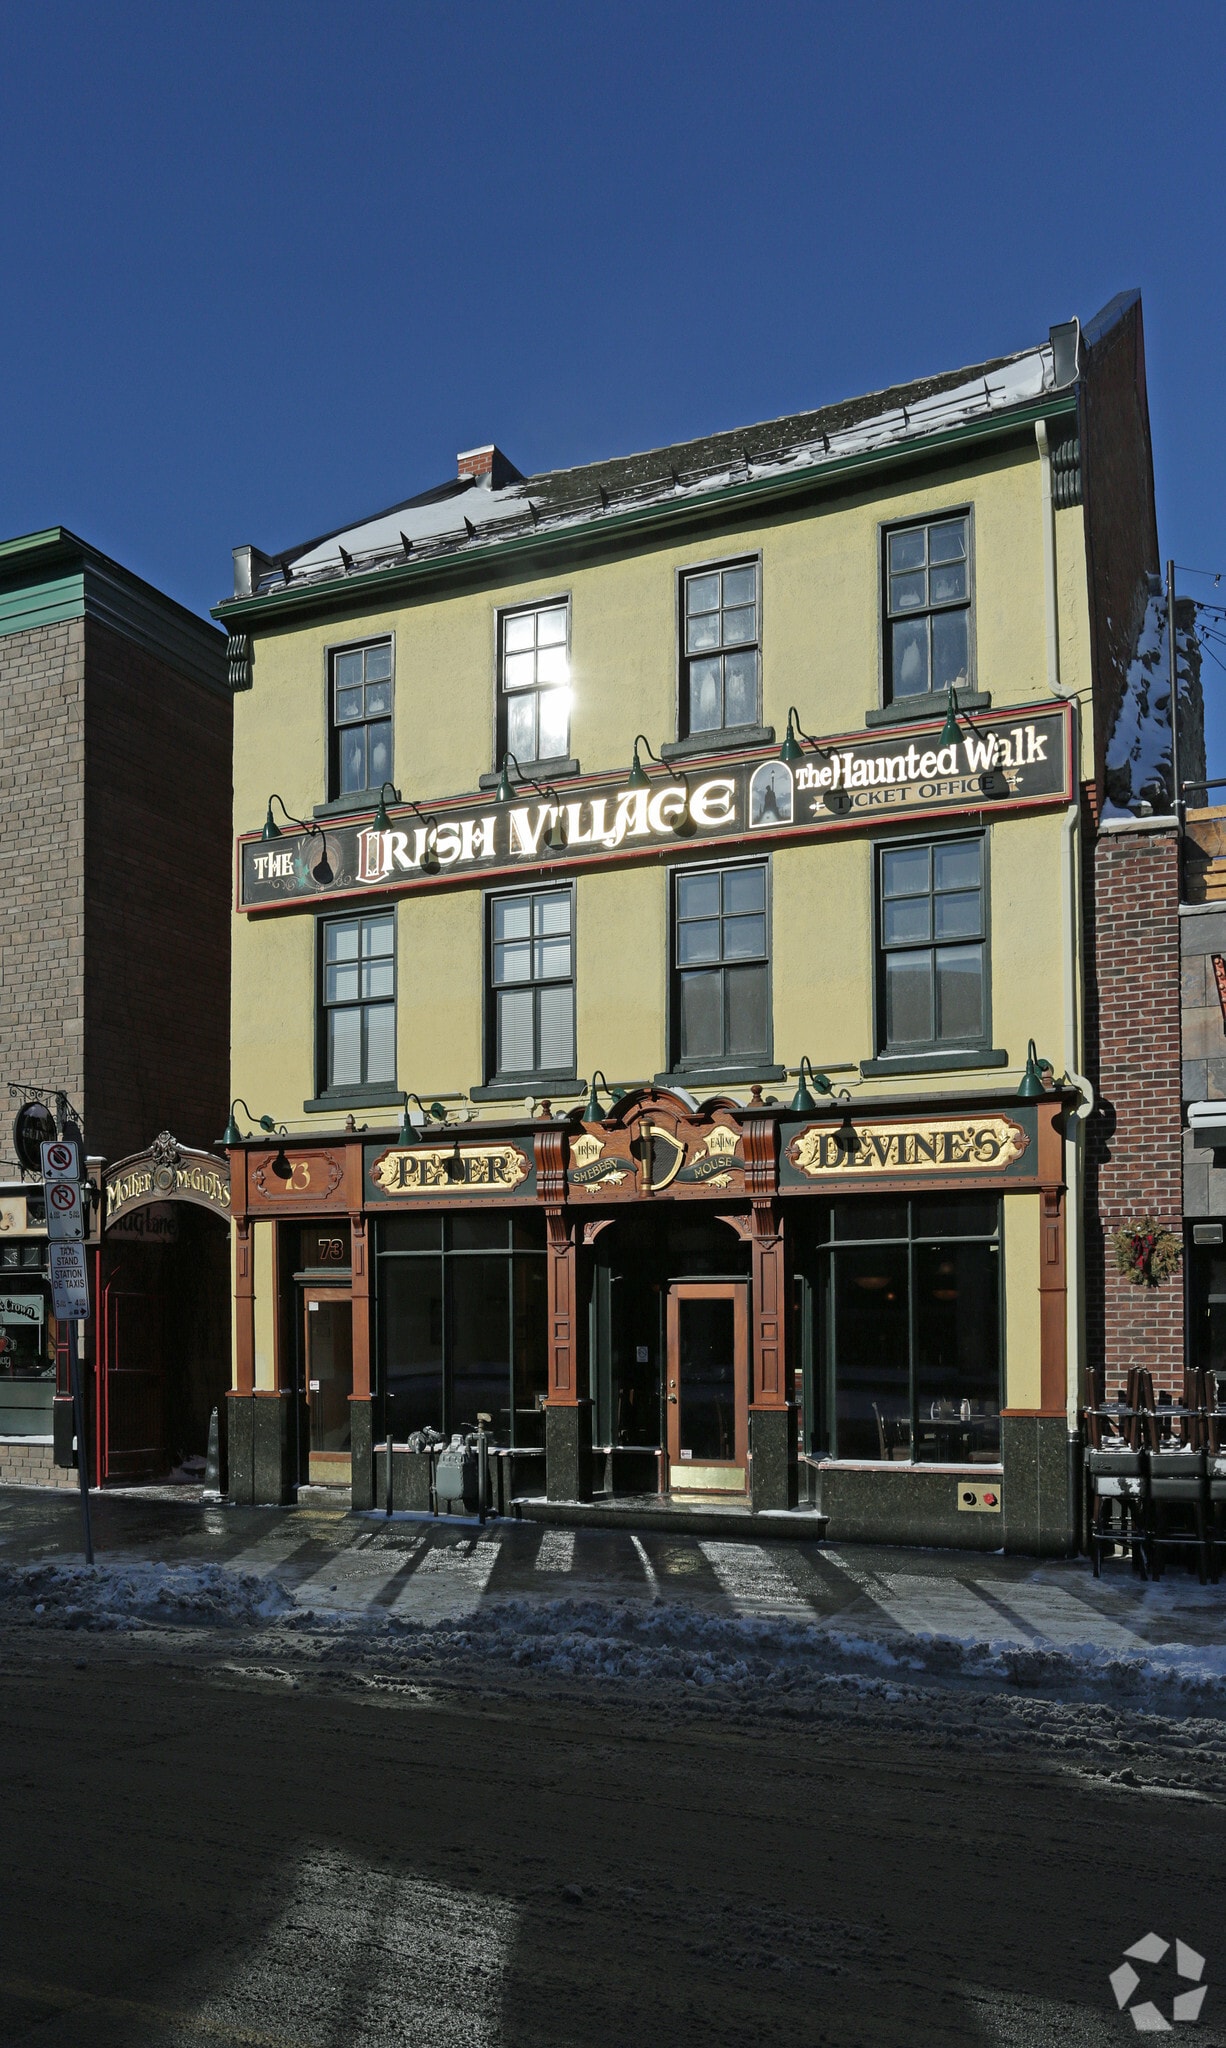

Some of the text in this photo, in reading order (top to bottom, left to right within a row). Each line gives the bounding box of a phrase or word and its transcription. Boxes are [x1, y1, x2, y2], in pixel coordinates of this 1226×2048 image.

[830, 744, 959, 790] Haunted
[963, 725, 1048, 772] Walk
[834, 776, 994, 809] TICKET OFFICE
[253, 779, 735, 882] THE IRISH VILLAGE
[577, 1141, 598, 1159] IRISH
[710, 1133, 735, 1152] EATING
[815, 1127, 999, 1168] DEVINE'S
[60, 1247, 75, 1256] TAXI
[318, 1238, 343, 1260] 73
[56, 1257, 79, 1266] STAND
[54, 1269, 82, 1280] STATION
[54, 1279, 85, 1289] DE TAXIS
[5, 1298, 39, 1320] Crown
